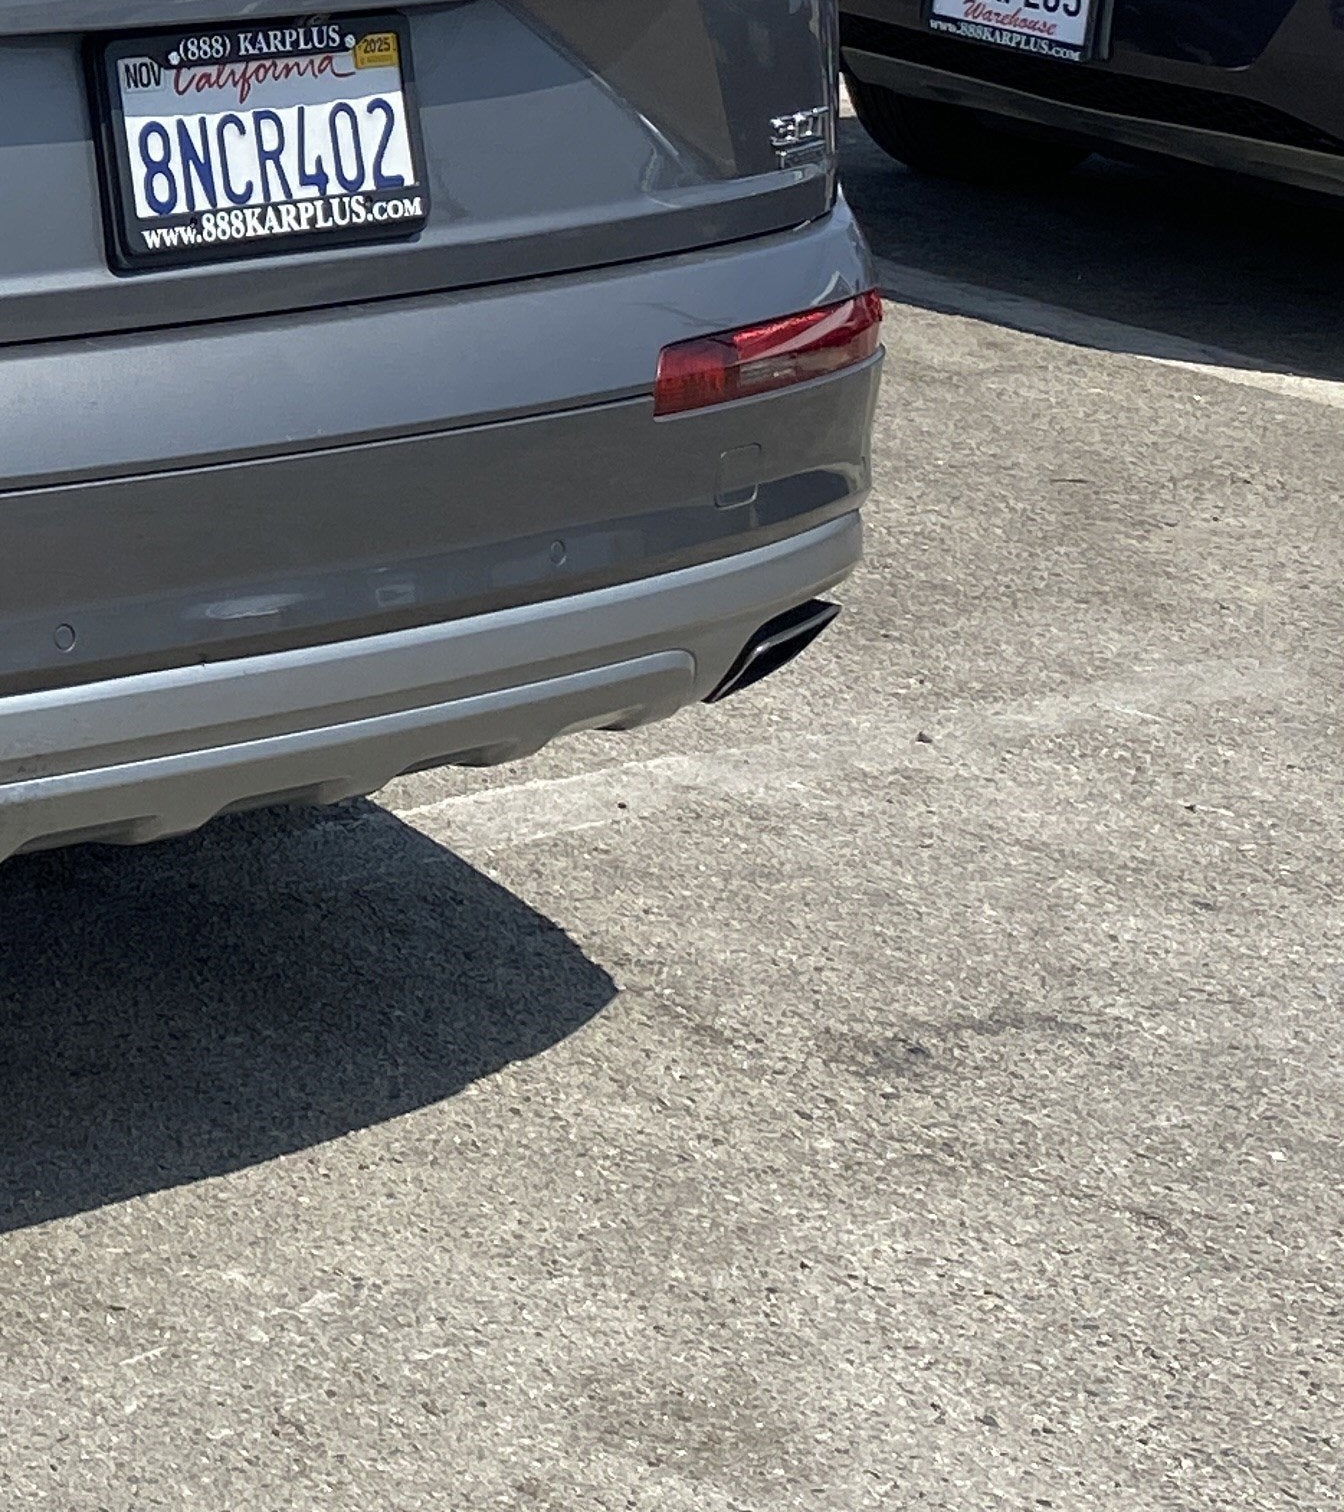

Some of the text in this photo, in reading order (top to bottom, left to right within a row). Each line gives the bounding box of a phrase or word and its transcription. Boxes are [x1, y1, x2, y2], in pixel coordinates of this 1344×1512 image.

[179, 25, 341, 62] (888) KARPLUS
[362, 36, 391, 55] 2025
[124, 60, 162, 89] NOV
[173, 53, 356, 105] California
[138, 97, 405, 216] 8NCR402
